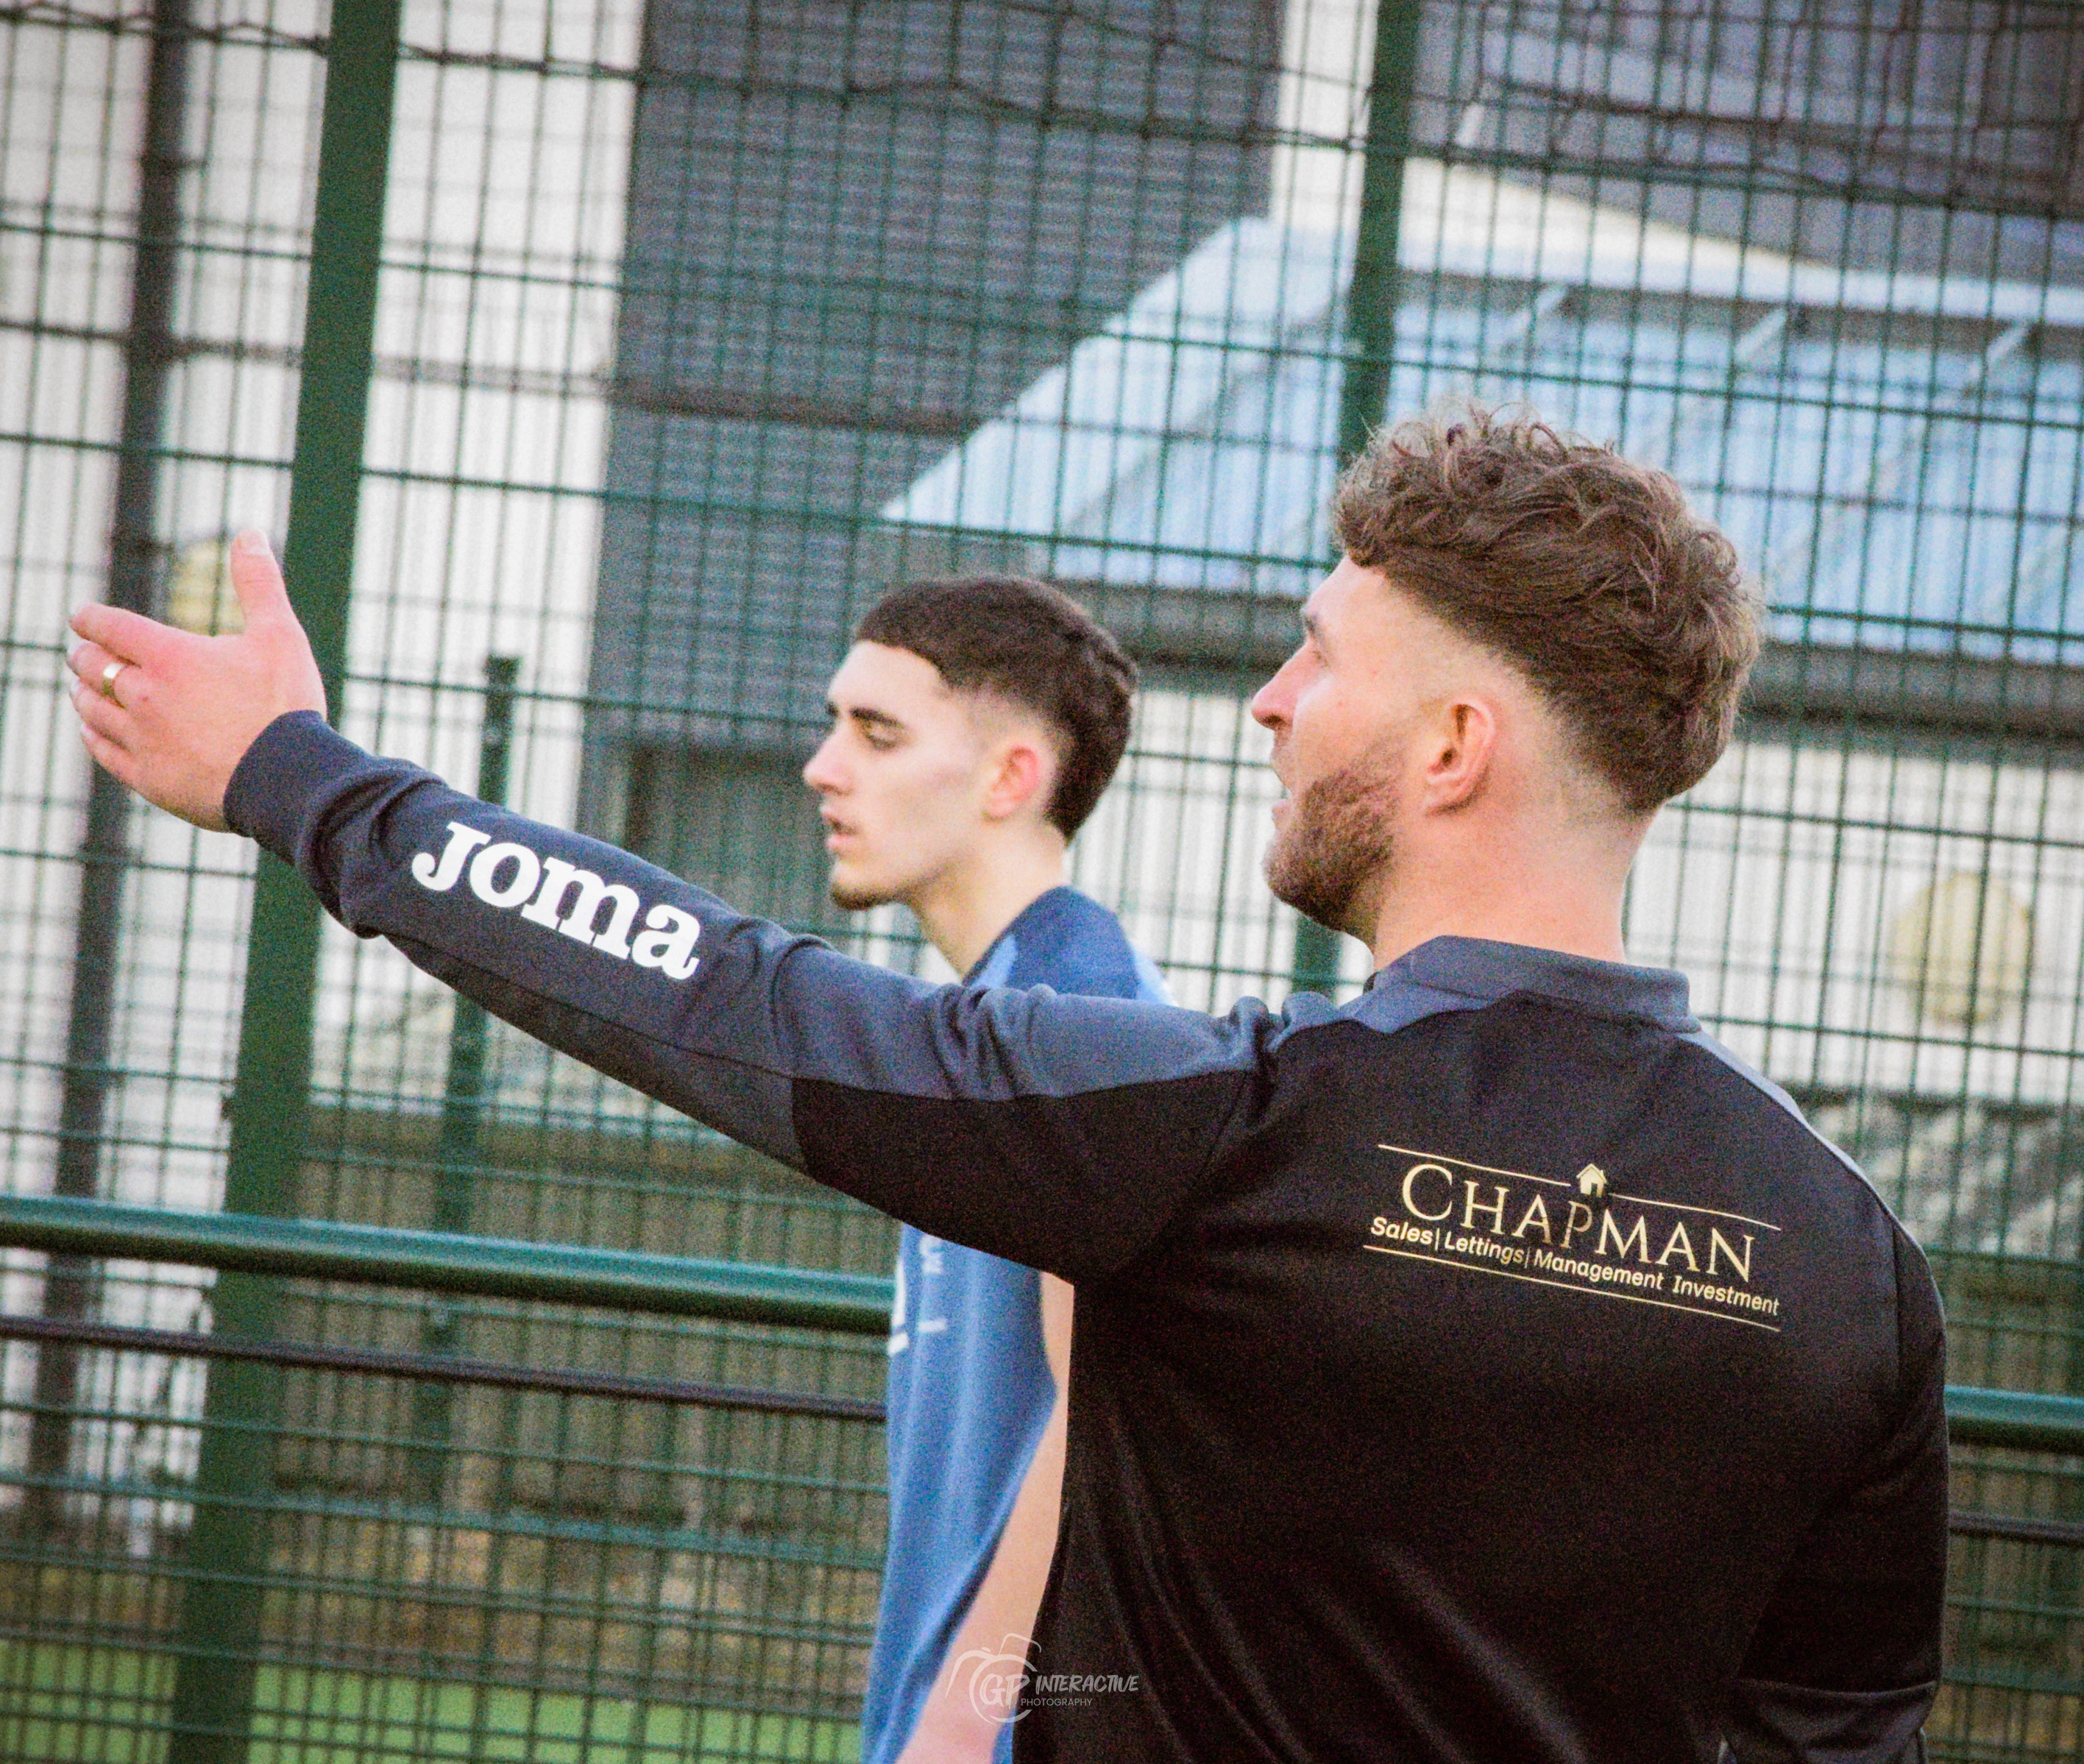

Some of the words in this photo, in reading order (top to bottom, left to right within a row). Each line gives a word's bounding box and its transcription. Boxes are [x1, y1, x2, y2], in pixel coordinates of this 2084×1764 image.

[411, 821, 701, 980] Joma
[1401, 1163, 1756, 1283] CHAPMAN
[1533, 1247, 1665, 1291] Management
[1672, 1275, 1780, 1317] Investment
